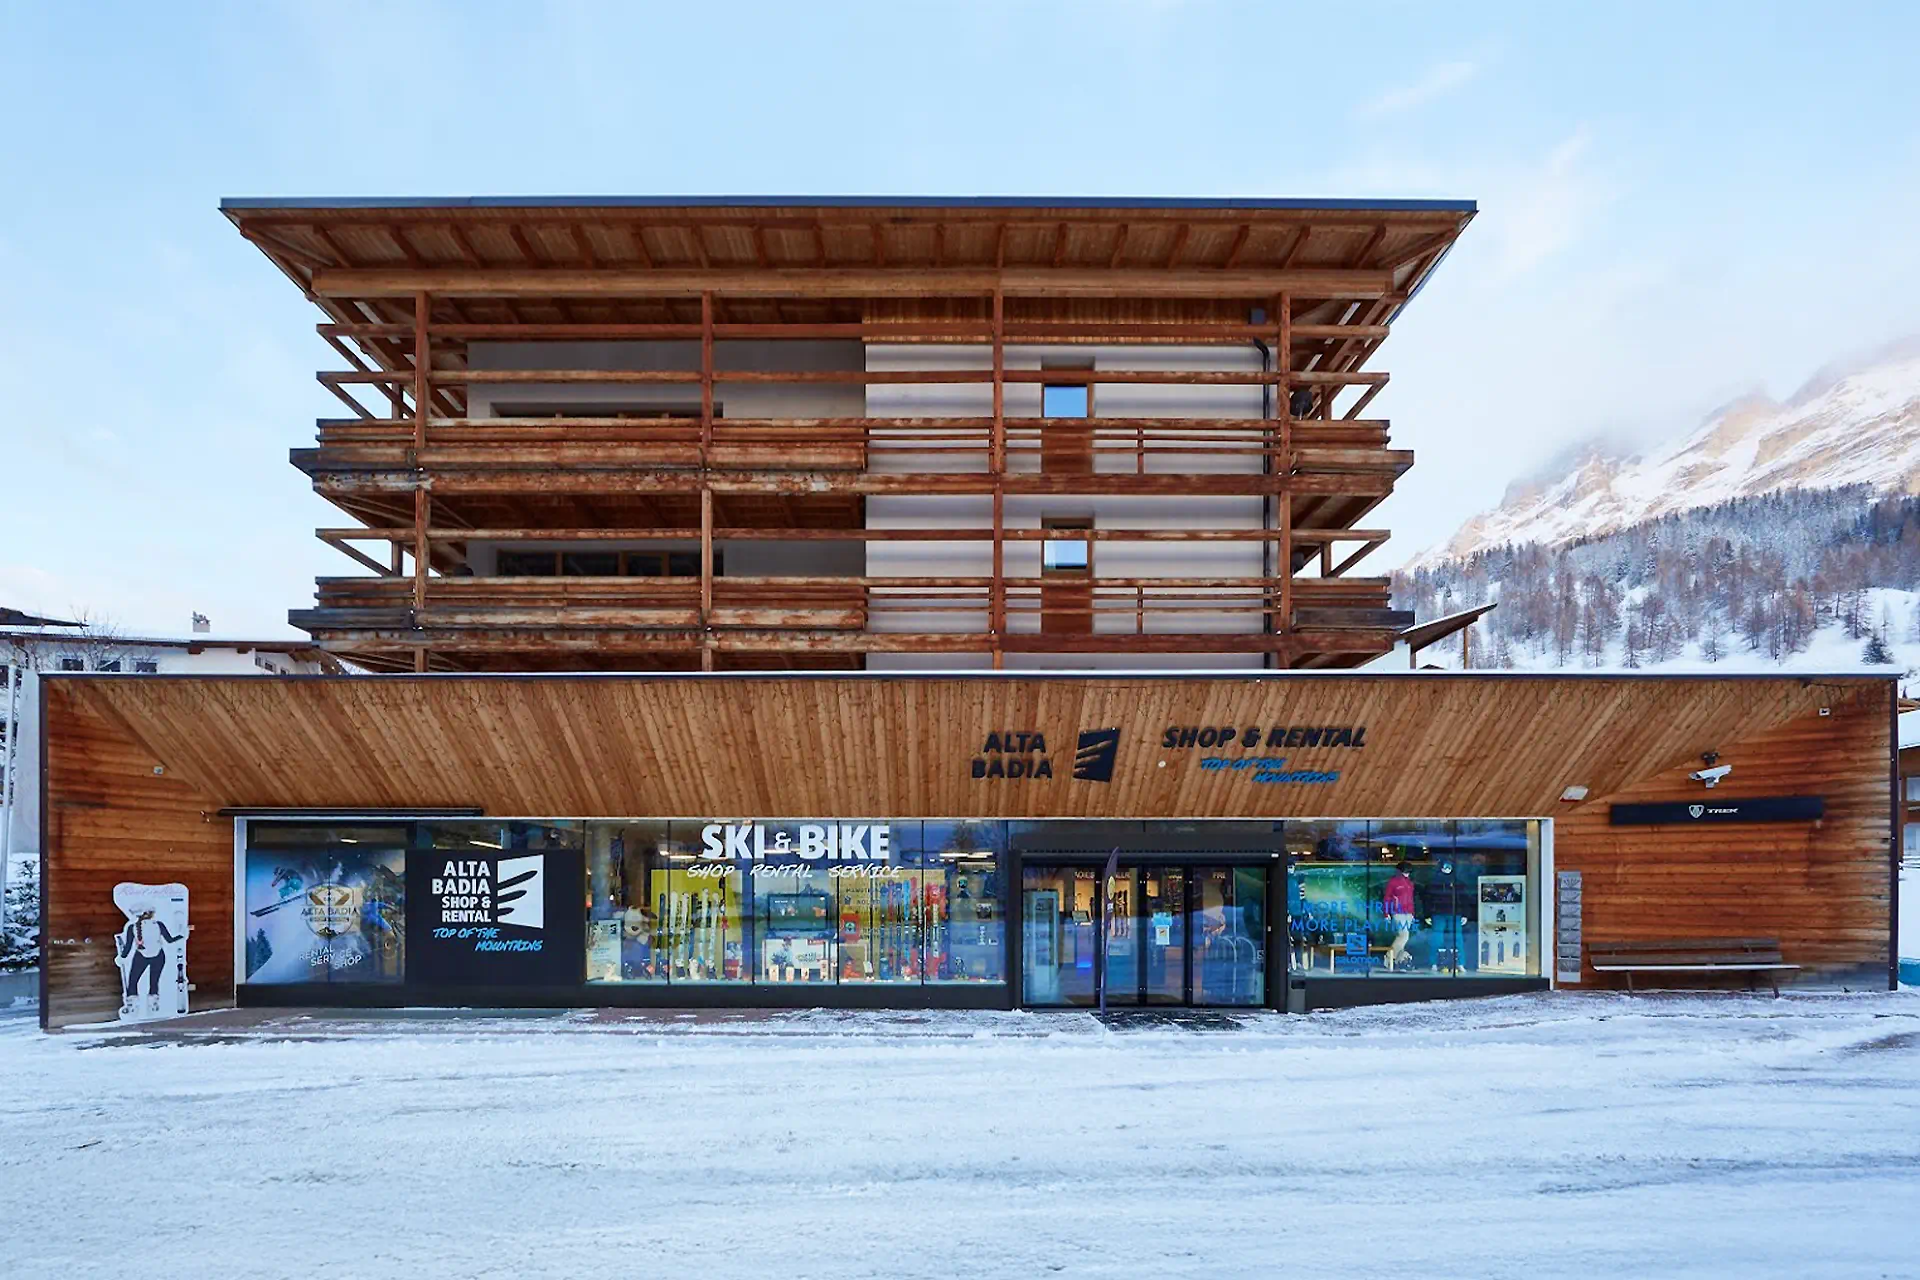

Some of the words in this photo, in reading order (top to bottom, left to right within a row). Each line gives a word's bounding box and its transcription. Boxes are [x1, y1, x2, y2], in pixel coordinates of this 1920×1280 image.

[983, 731, 1047, 753] ALTA
[1162, 726, 1237, 748] SHOP
[1241, 726, 1262, 748] &
[1265, 726, 1367, 748] RENTAL
[971, 757, 1053, 778] BADIA
[1201, 757, 1231, 770] TOP
[701, 823, 765, 860] SKI
[774, 831, 792, 851] &
[799, 823, 890, 860] BIKE
[443, 860, 491, 877] ALTA
[687, 863, 736, 880] SHOP
[749, 864, 813, 879] RENTAL
[828, 863, 904, 878] SERVICE
[432, 878, 491, 895] BADIA
[441, 896, 479, 909] SHOP
[481, 896, 492, 909] &
[1301, 900, 1349, 914] MORE
[441, 910, 492, 923] RENTAL
[1291, 918, 1338, 932] MORE
[433, 928, 457, 938] TOP
[458, 928, 475, 938] OF
[475, 927, 501, 939] THE
[298, 943, 336, 961] RENTAL
[475, 939, 544, 951] MOUNTAINS
